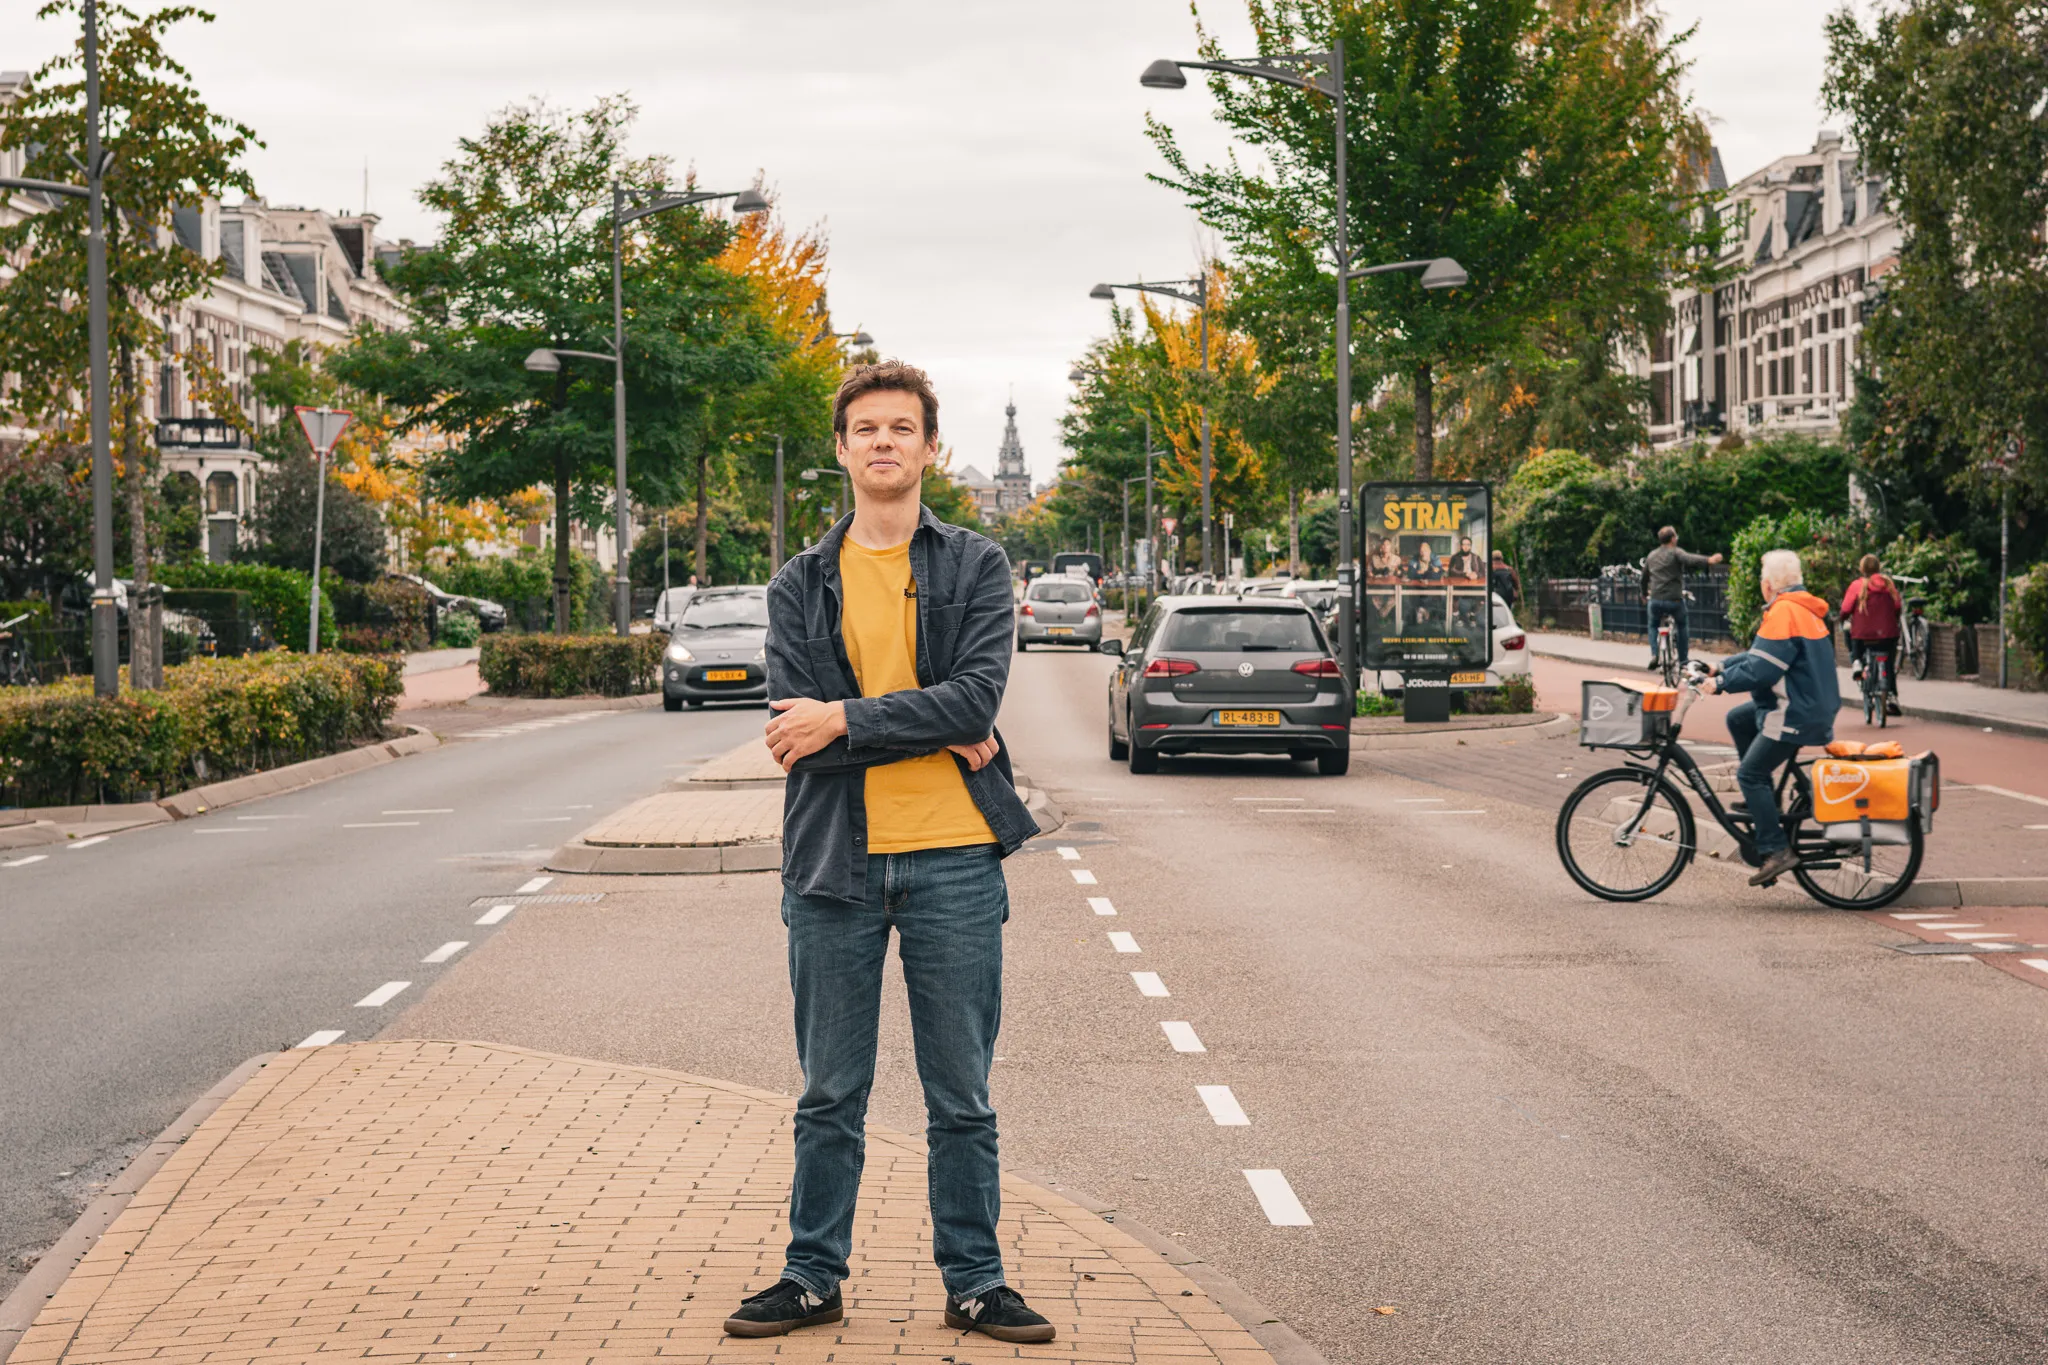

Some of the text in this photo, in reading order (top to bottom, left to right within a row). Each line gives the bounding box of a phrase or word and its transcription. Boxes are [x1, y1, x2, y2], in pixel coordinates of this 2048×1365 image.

[1383, 502, 1467, 530] STRAF
[1406, 679, 1448, 688] JCDecaux
[1223, 712, 1275, 722] RL-483-B
